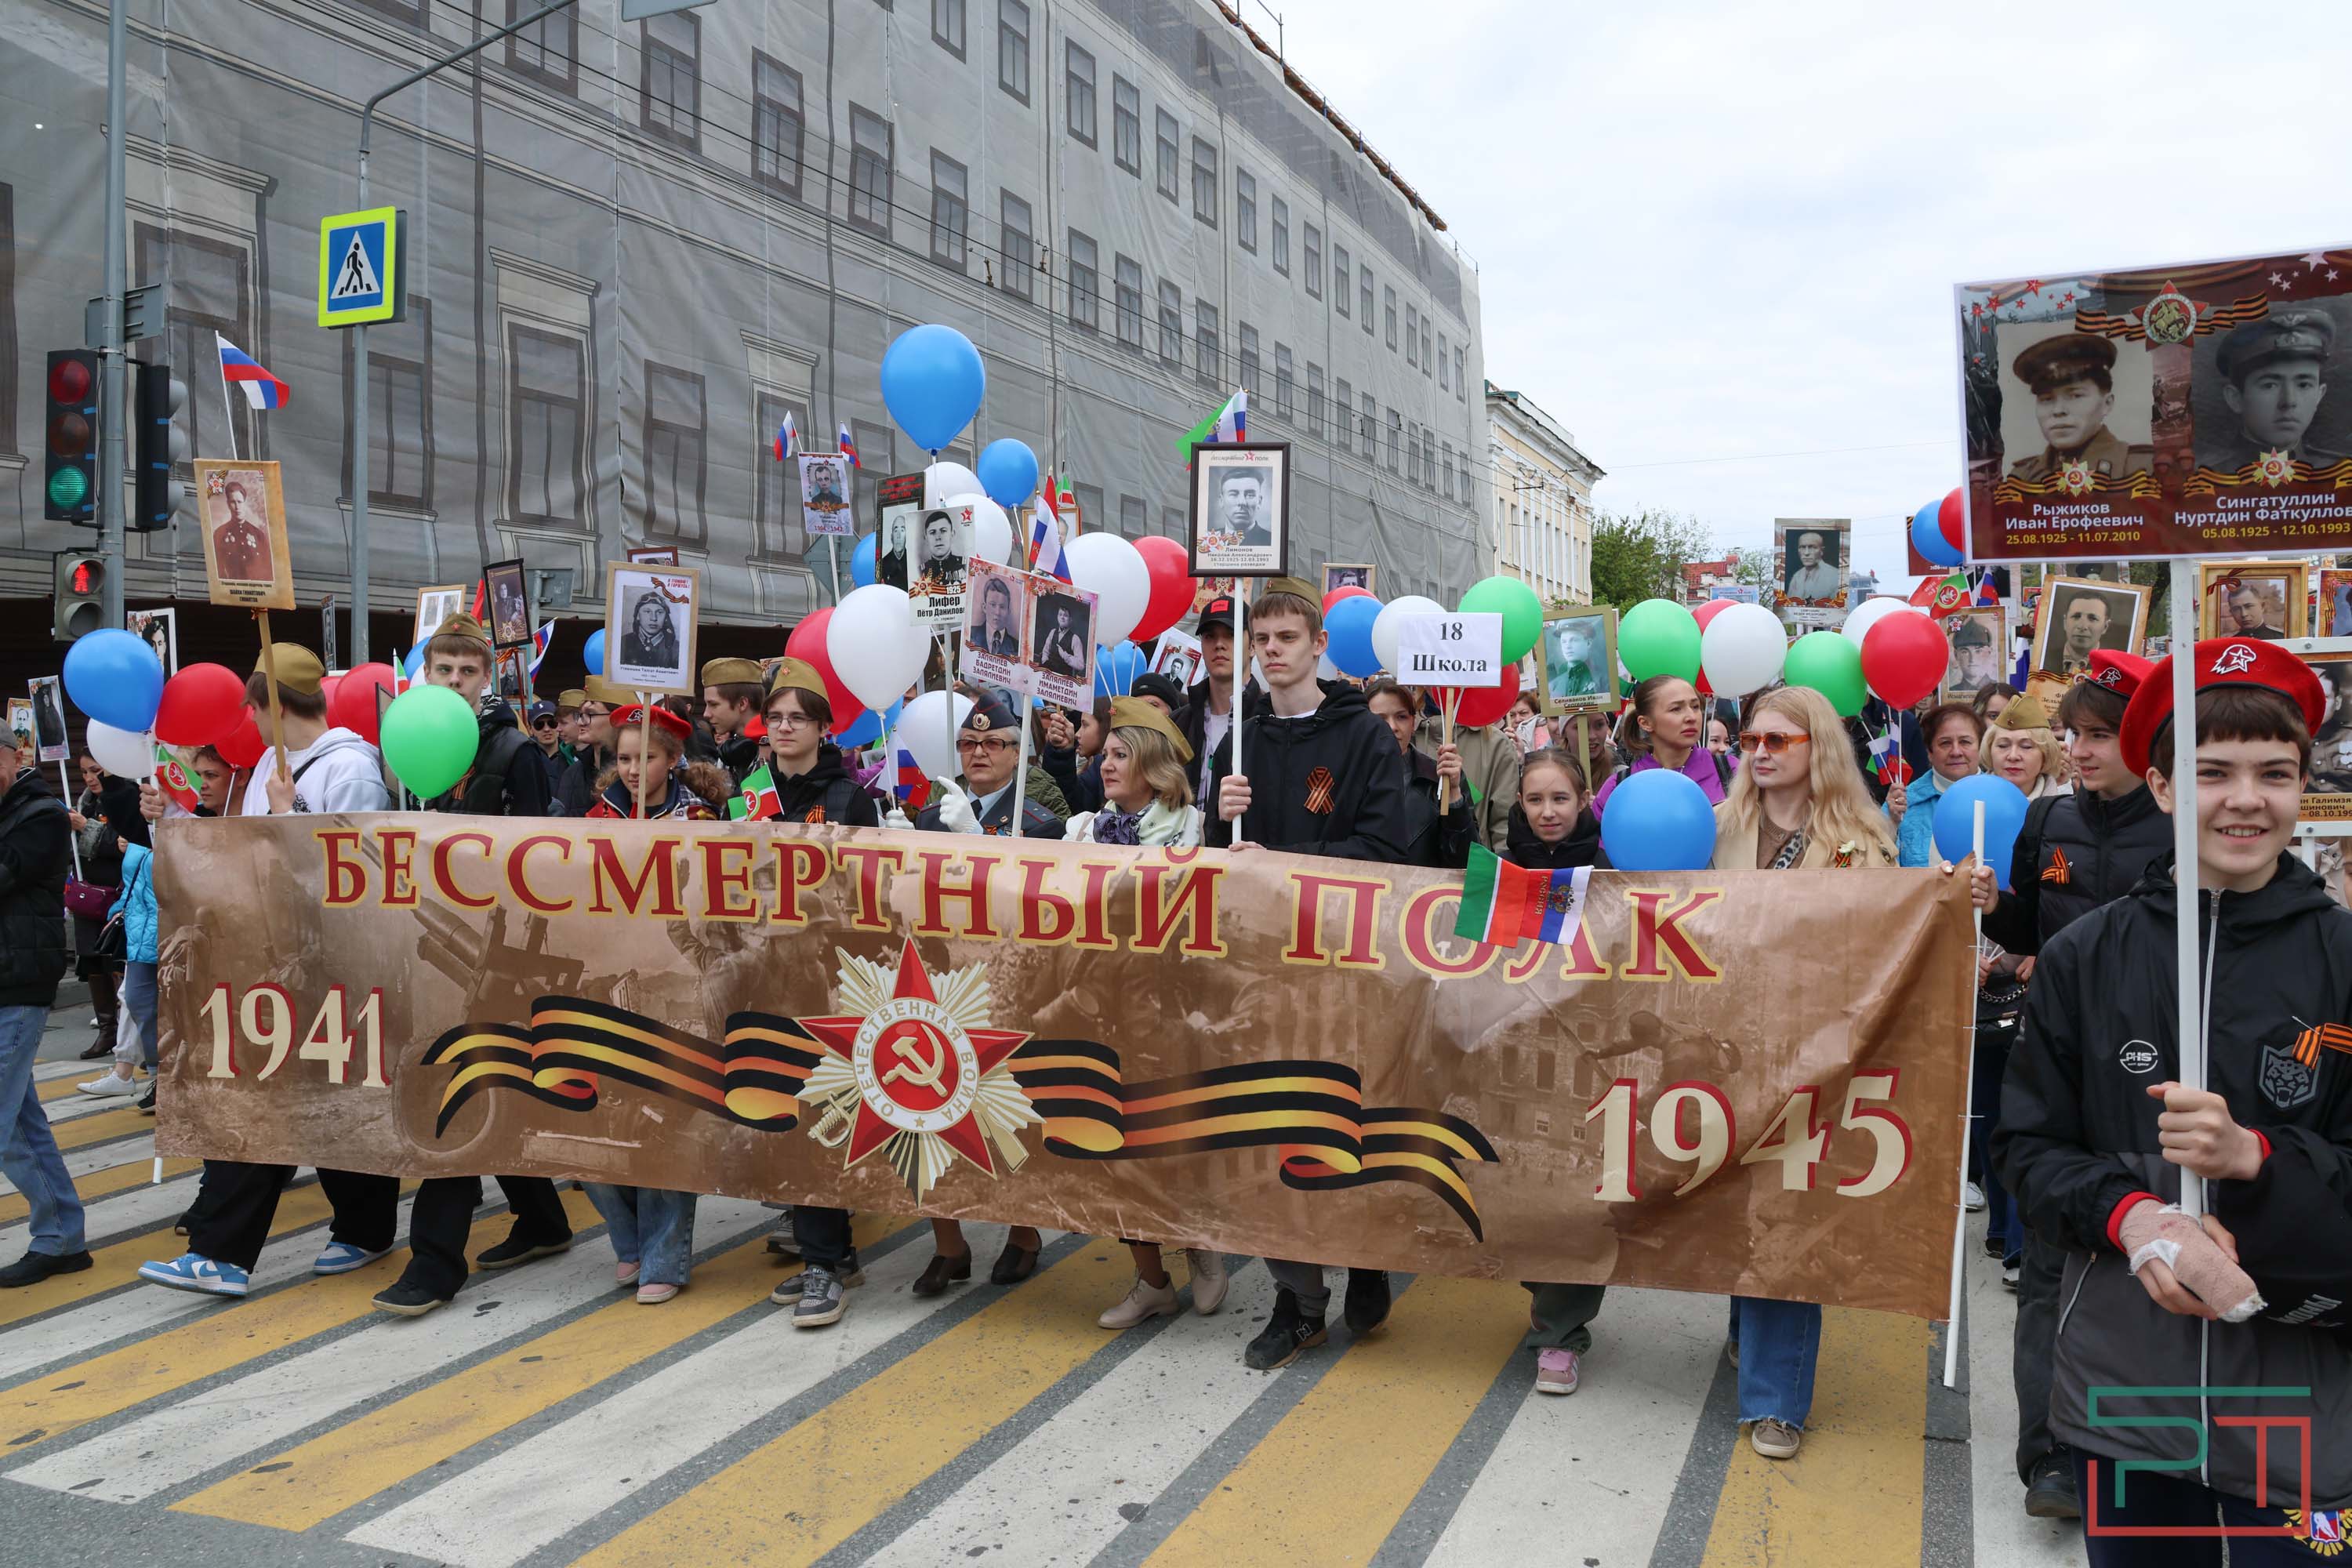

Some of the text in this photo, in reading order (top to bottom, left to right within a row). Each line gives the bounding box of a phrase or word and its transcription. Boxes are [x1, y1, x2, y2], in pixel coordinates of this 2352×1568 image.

[2033, 503, 2110, 516] Рыжиков
[2216, 493, 2336, 509] Сингатуллин
[2005, 515, 2143, 532] Иван Ерофеевич
[2175, 511, 2250, 527] Нуртдин
[2006, 533, 2067, 545] 25.08.1925
[2078, 532, 2140, 543] 11.07.2010
[2202, 526, 2270, 539] 05.08.1925
[2281, 522, 2350, 535] 12.10.1993
[946, 585, 961, 594] 1925
[929, 597, 960, 608] Лифер
[916, 608, 933, 618] Пётр
[1439, 622, 1463, 641] 18
[975, 659, 1011, 677] БАДРЕТДИН
[978, 652, 1008, 667] ЗАЛЯЛИЕВ
[1412, 654, 1487, 672] Школа
[973, 666, 1011, 684] ЗАЛЯЛИЕВИЧ
[1041, 672, 1073, 688] ЗАЛЯЛИЕВ
[1036, 687, 1077, 706] ЗАЛЯЛИЕВИЧ
[1039, 680, 1078, 699] ИМАМЕТДИН
[314, 828, 1228, 958] БЕССМЕРТНЫЙ
[200, 982, 392, 1088] 1941
[855, 1000, 978, 1122] ОТЕЧЕСТВЕННАЯ ВОЙНА
[1585, 1067, 1913, 1203] 1945
